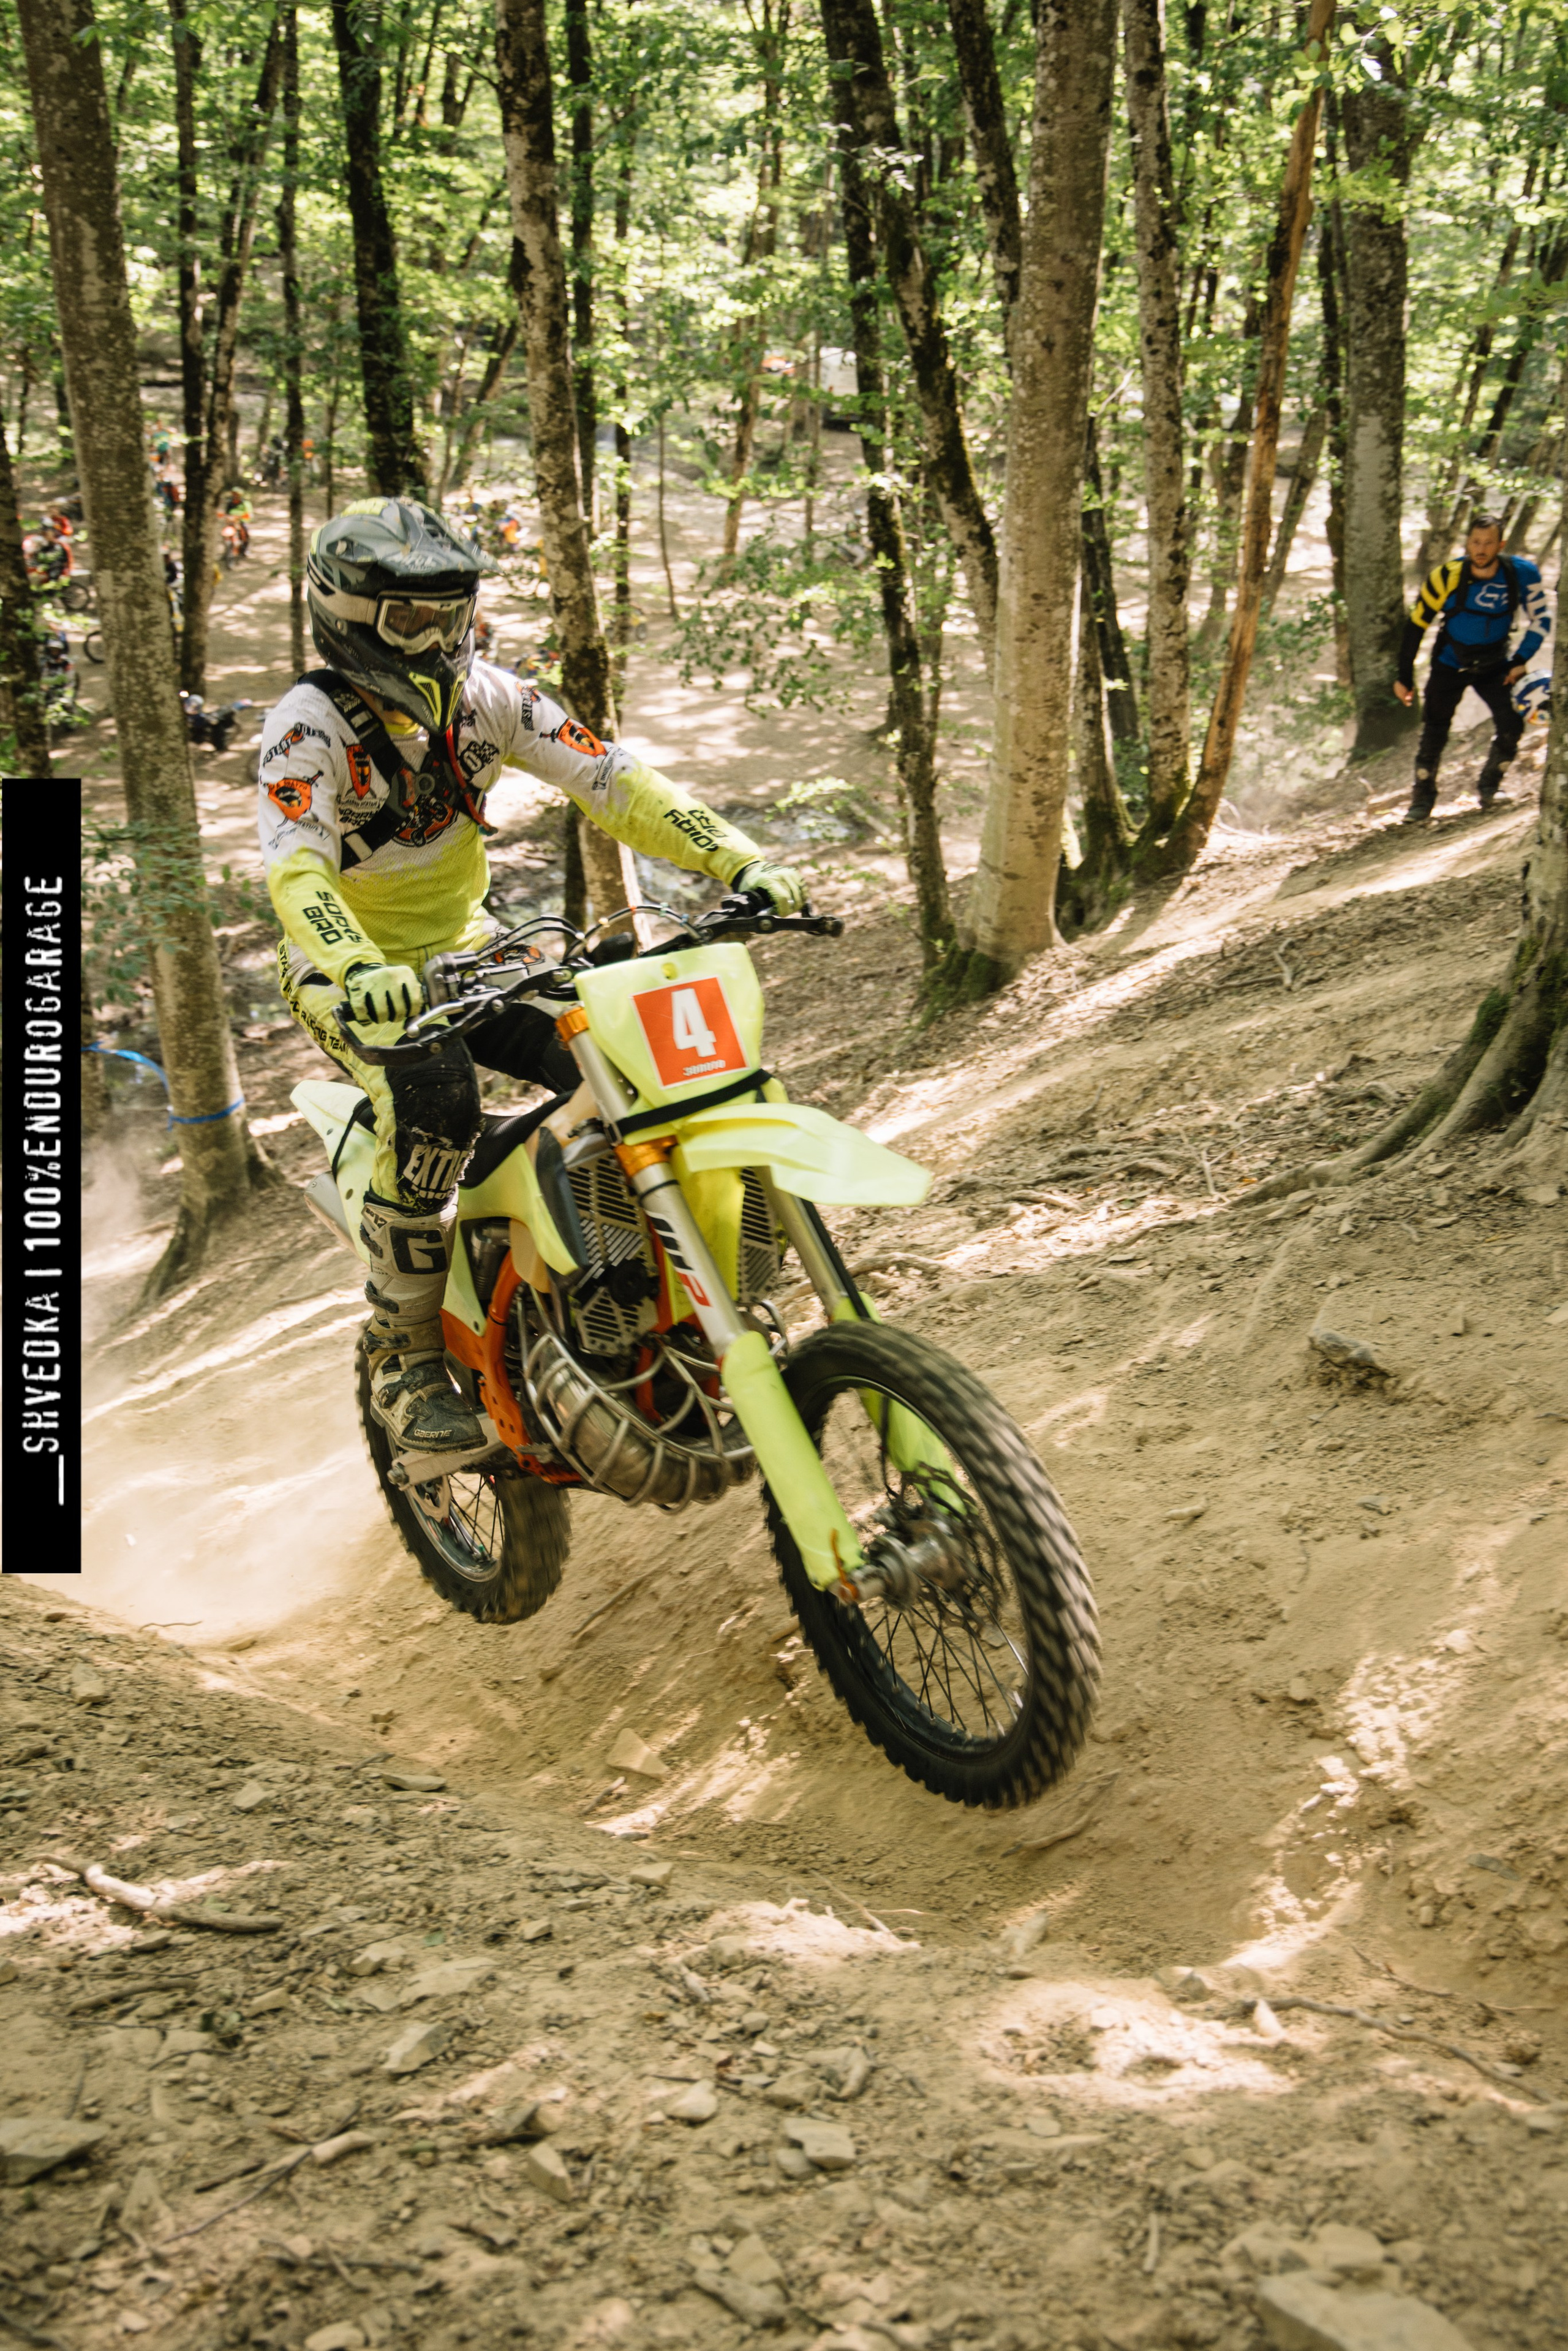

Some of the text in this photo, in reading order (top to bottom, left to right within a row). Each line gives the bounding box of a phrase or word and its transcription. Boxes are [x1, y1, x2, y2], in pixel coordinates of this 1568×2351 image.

[302, 905, 344, 945] BRO
[671, 987, 717, 1058] 4
[413, 1428, 453, 1438] GAERNE
